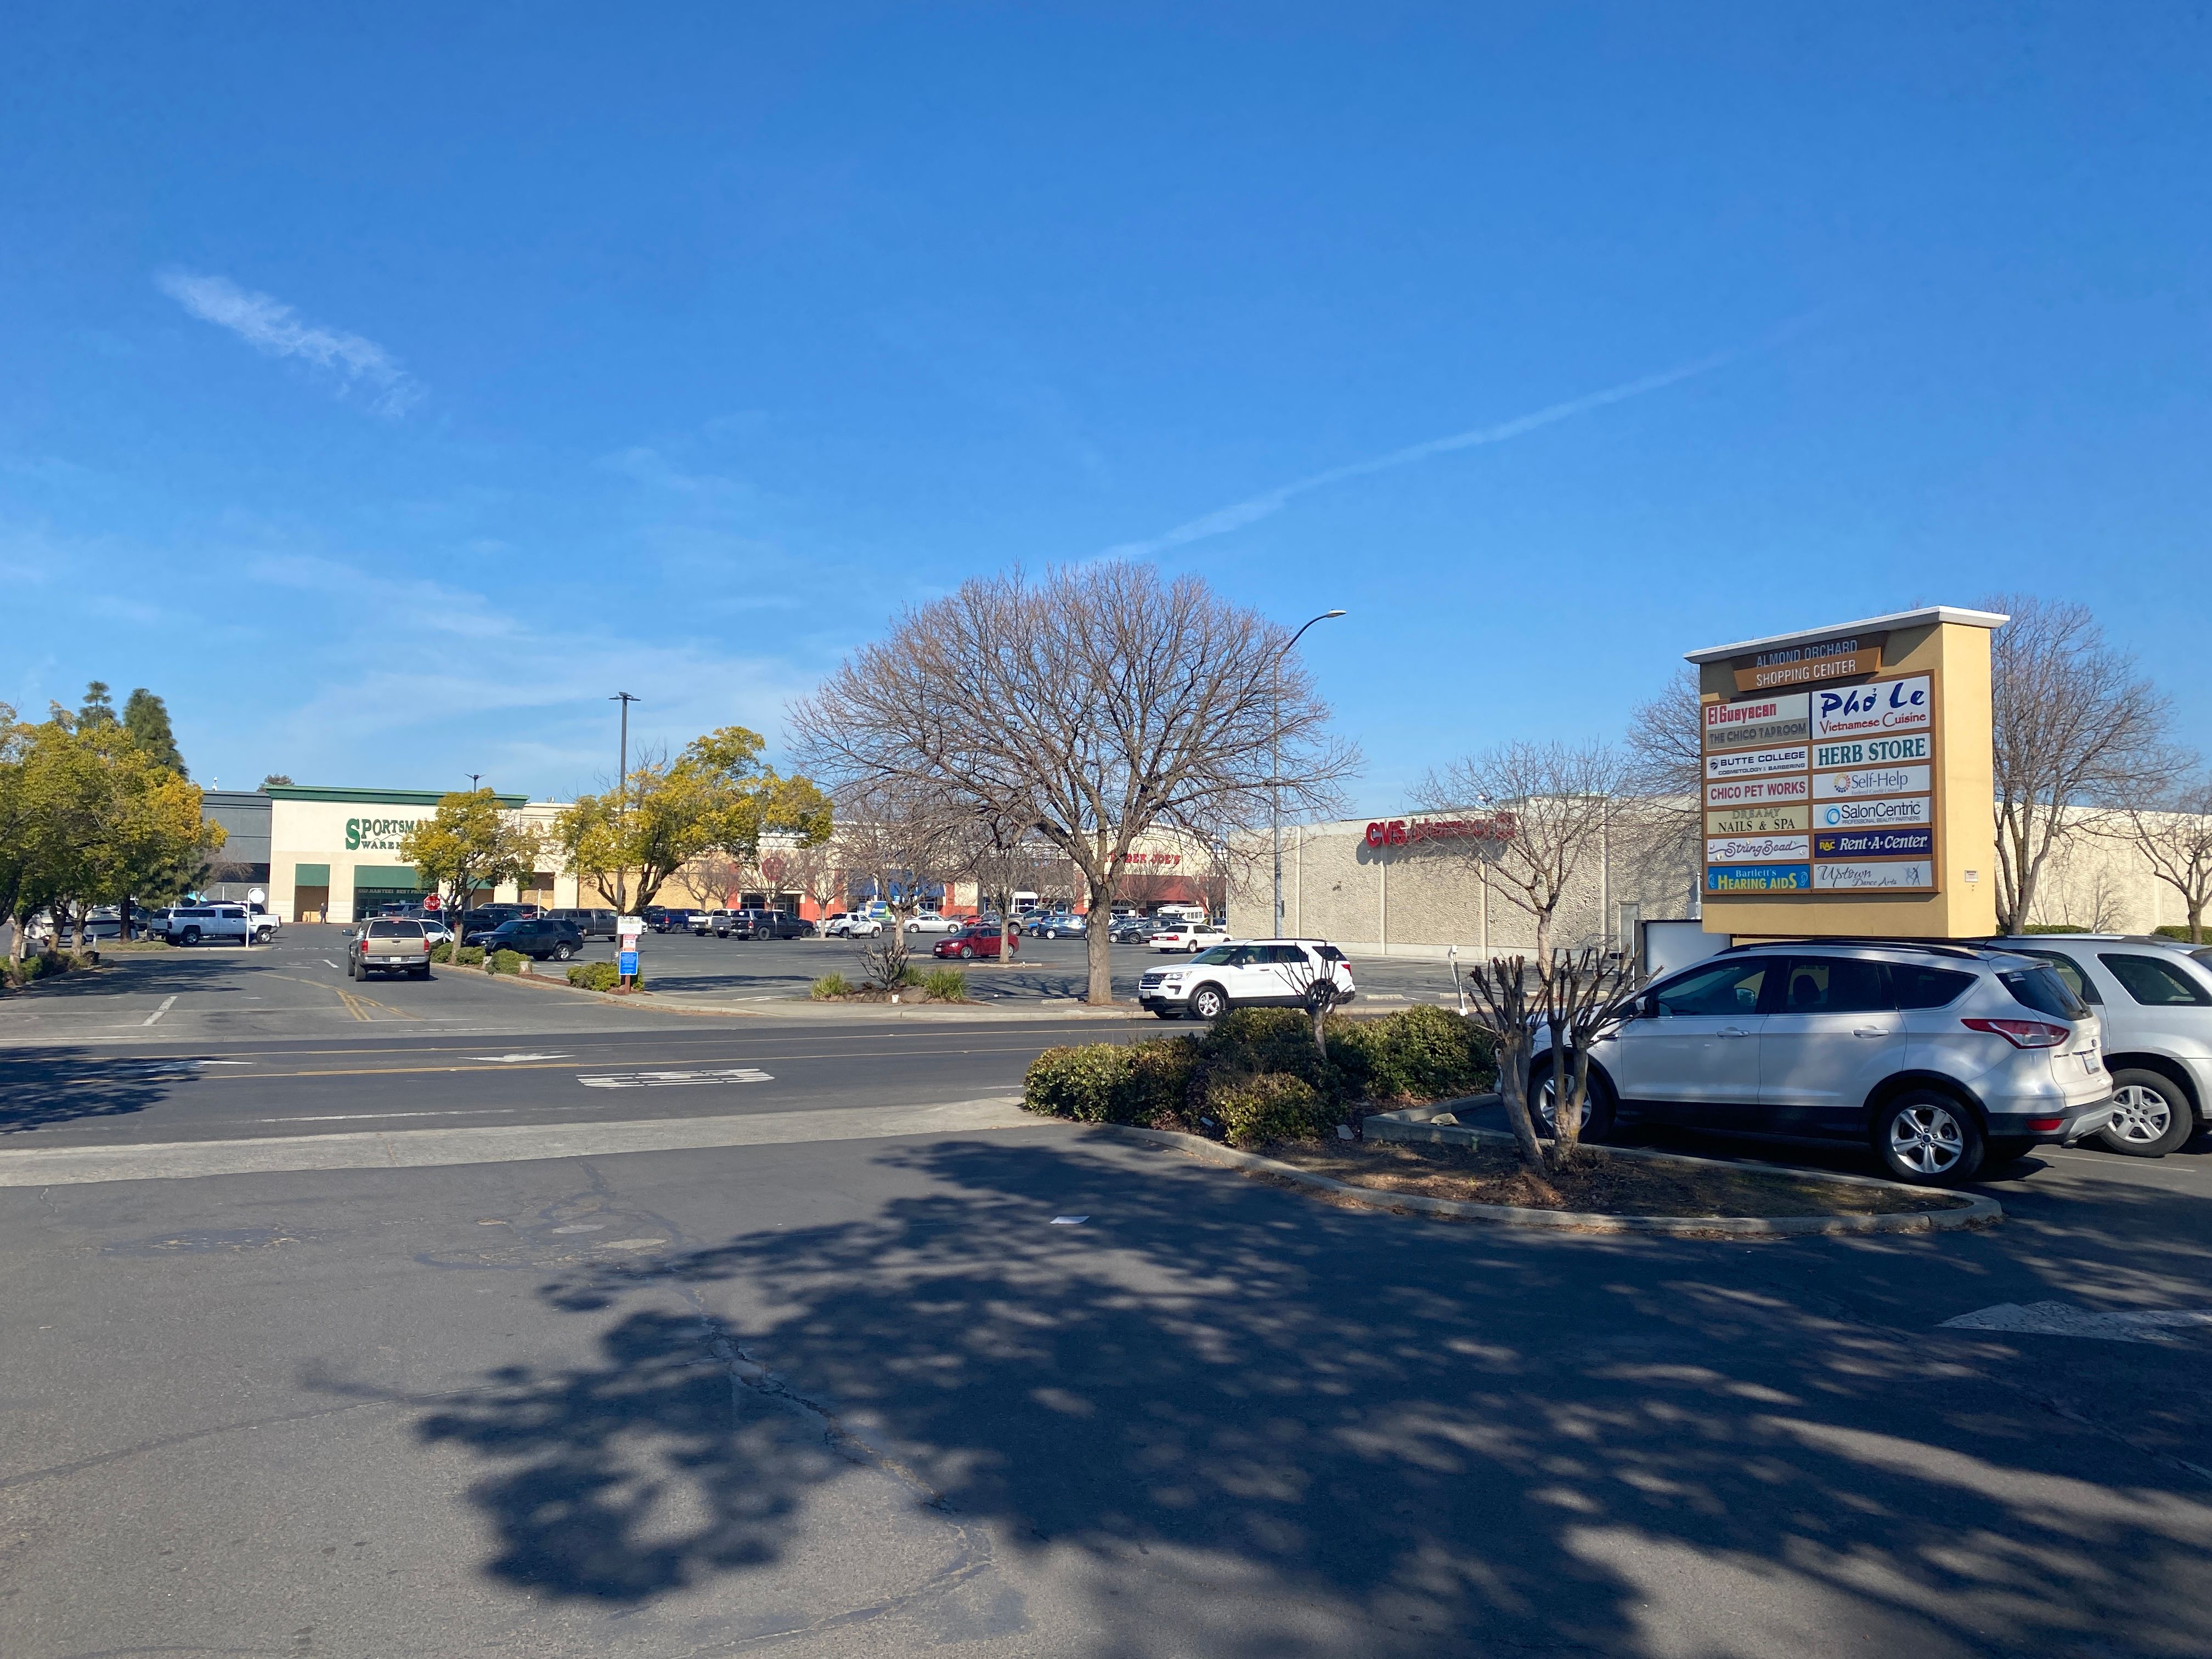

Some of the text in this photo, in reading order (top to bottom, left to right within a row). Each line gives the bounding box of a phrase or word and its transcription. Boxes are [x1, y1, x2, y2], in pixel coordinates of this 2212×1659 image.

[1757, 640, 1858, 668] ALMOND ORCHARD
[1756, 659, 1856, 686] SHOPPING CENTER
[1889, 682, 1925, 708] Le
[1708, 704, 1777, 725] El Guayacan
[1819, 712, 1926, 735] Vietnamese Cuisine
[1709, 722, 1807, 744] THE CHICO TAPROOM
[1720, 751, 1805, 766] BUTTE COLLEGE
[1818, 738, 1926, 766] HERB STORE
[1851, 770, 1908, 790] Self-Help
[1711, 781, 1806, 800] CHICO PET WORKS
[1732, 808, 1781, 820] DREAMY
[1841, 800, 1921, 819] SalonCentric
[1718, 818, 1795, 833] NAILS & SPA
[1819, 841, 1835, 851] RAC
[1718, 872, 1797, 890] HEARING AIDS
[1735, 869, 1776, 877] Bartlett's
[1818, 865, 1871, 888] Uptown
[1878, 877, 1897, 887] Arts
